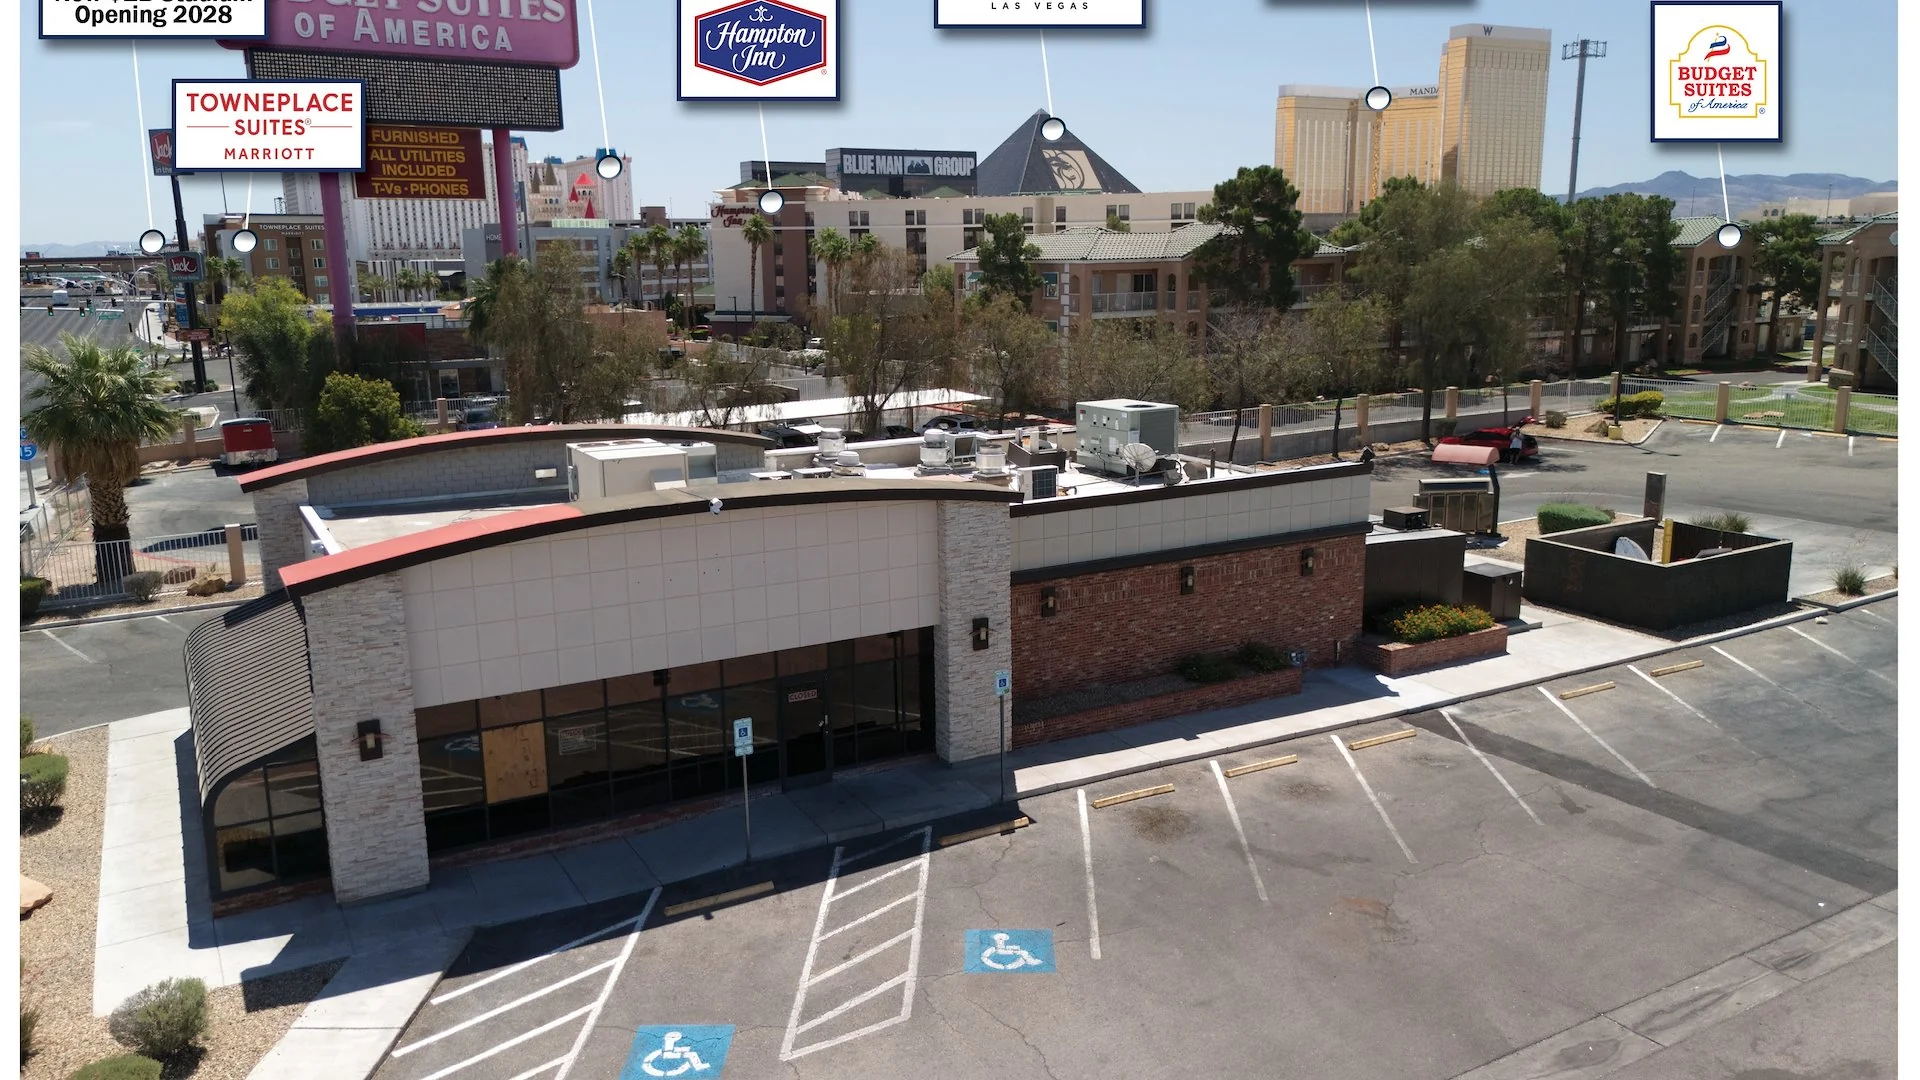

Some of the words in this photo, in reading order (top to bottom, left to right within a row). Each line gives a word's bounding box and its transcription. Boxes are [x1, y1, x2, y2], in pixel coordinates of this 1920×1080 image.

[294, 12, 335, 39] OF
[353, 8, 513, 51] AMERICA
[1483, 26, 1493, 36] W
[371, 129, 460, 143] FURNISHED
[370, 148, 397, 160] ALL
[400, 149, 466, 163] UTILITIES
[381, 163, 457, 177] INCLUDED
[842, 154, 875, 174] BLUE
[875, 155, 902, 175] MAN
[934, 156, 975, 177] GROUP
[371, 182, 402, 195] T-Vs
[410, 183, 469, 196] PHONES
[711, 204, 760, 218] Hampton
[723, 215, 747, 228] Inn
[170, 257, 198, 273] Jack
[789, 690, 817, 701] CLOSED
